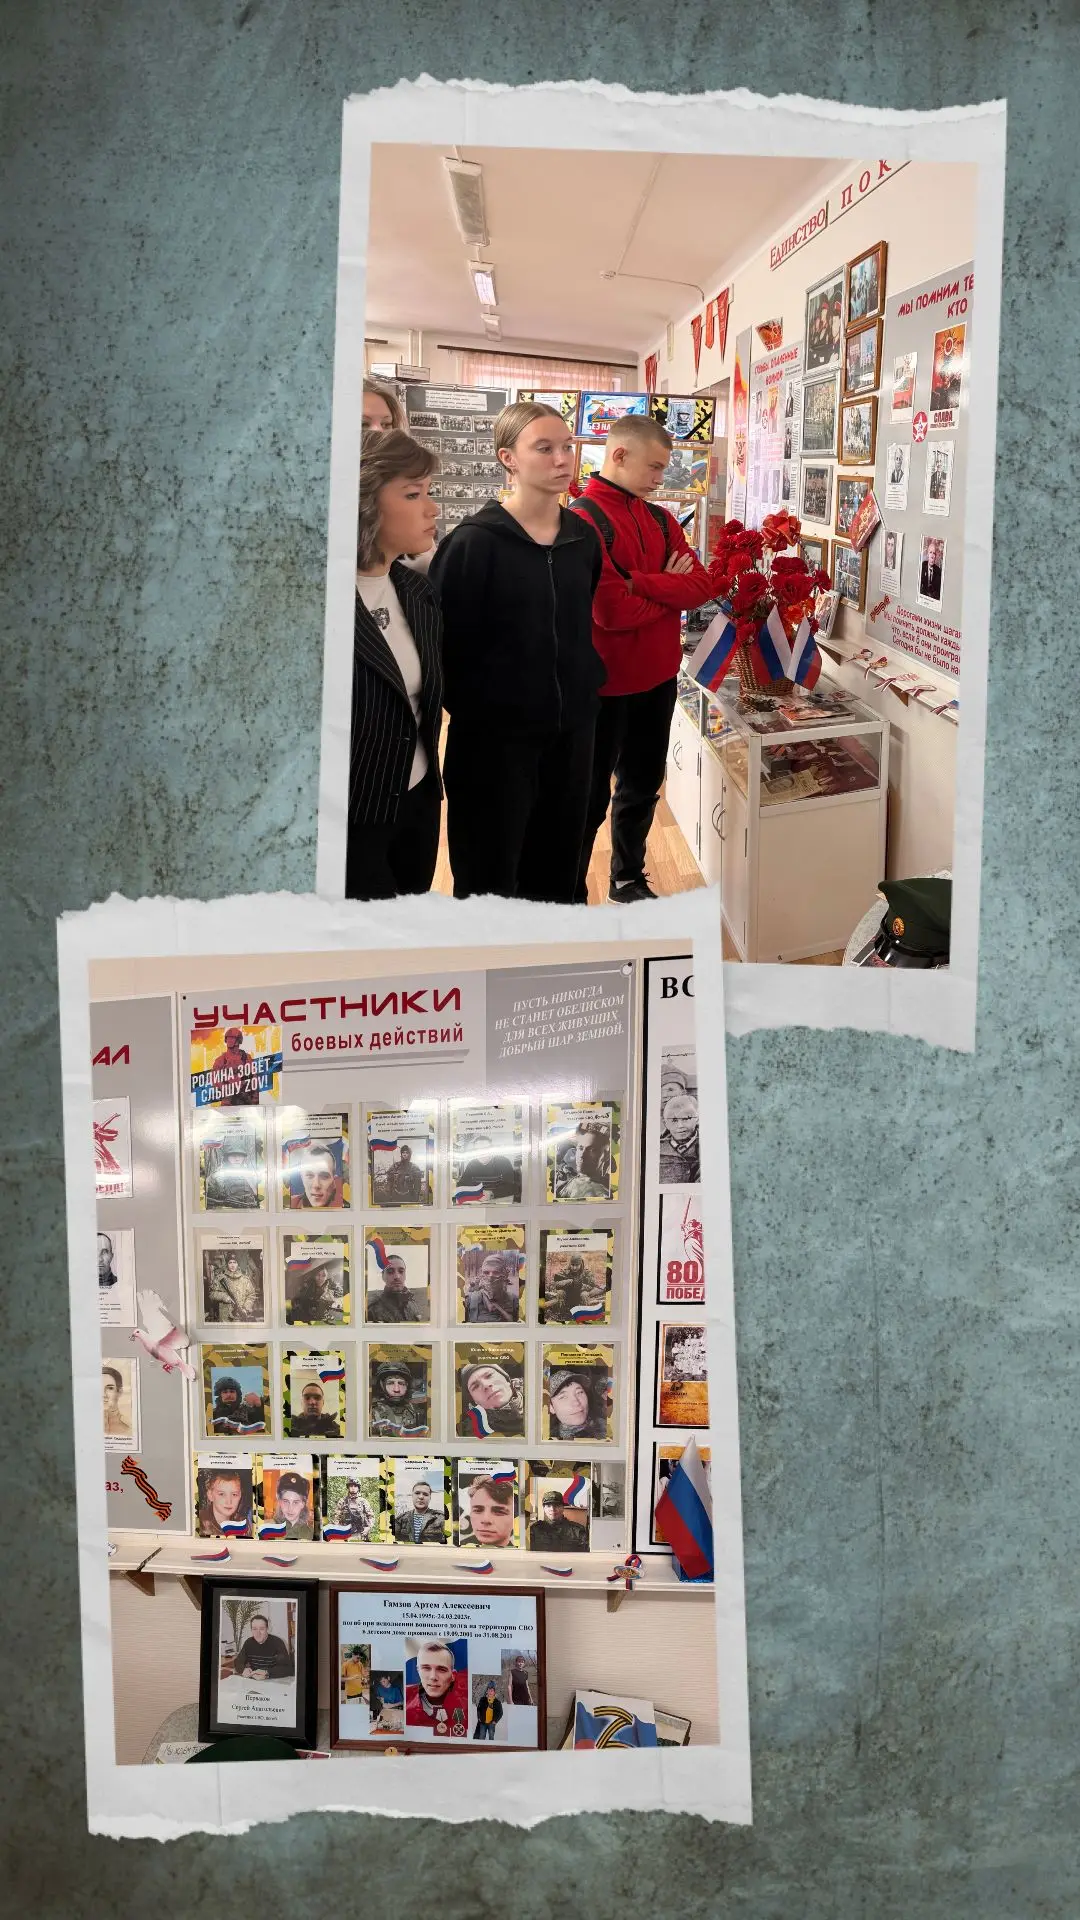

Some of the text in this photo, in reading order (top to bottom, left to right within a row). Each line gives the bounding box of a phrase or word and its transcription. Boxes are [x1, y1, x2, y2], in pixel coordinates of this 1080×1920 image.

[769, 207, 826, 270] ЕДИНСТВО
[897, 299, 913, 317] МЫ
[916, 280, 959, 310] ПОМНИМ
[947, 298, 968, 318] КТО
[915, 625, 940, 641] должны
[920, 639, 932, 650] они
[932, 654, 950, 670] было
[193, 986, 462, 1029] УЧАСТНИКИ
[494, 994, 625, 1031] НЕ СТАНЕТ ОБЕЛИСКОМ
[513, 984, 604, 1013] ПУСТЬ НИКОГДА
[291, 1022, 464, 1053] боевых действий
[502, 1009, 619, 1044] ДЛЯ ВСЕХ ЖИВУЩИХ
[498, 1037, 546, 1059] ДОБРЫЙ
[547, 1033, 574, 1048] ШАР
[192, 1066, 235, 1089] РОДИНА
[237, 1057, 271, 1078] ЗОВЁТ
[201, 1074, 268, 1103] СЛЫШУ ZOV!
[667, 1260, 699, 1284] 80
[383, 1599, 491, 1610] Гамзов Артем Алексеевич
